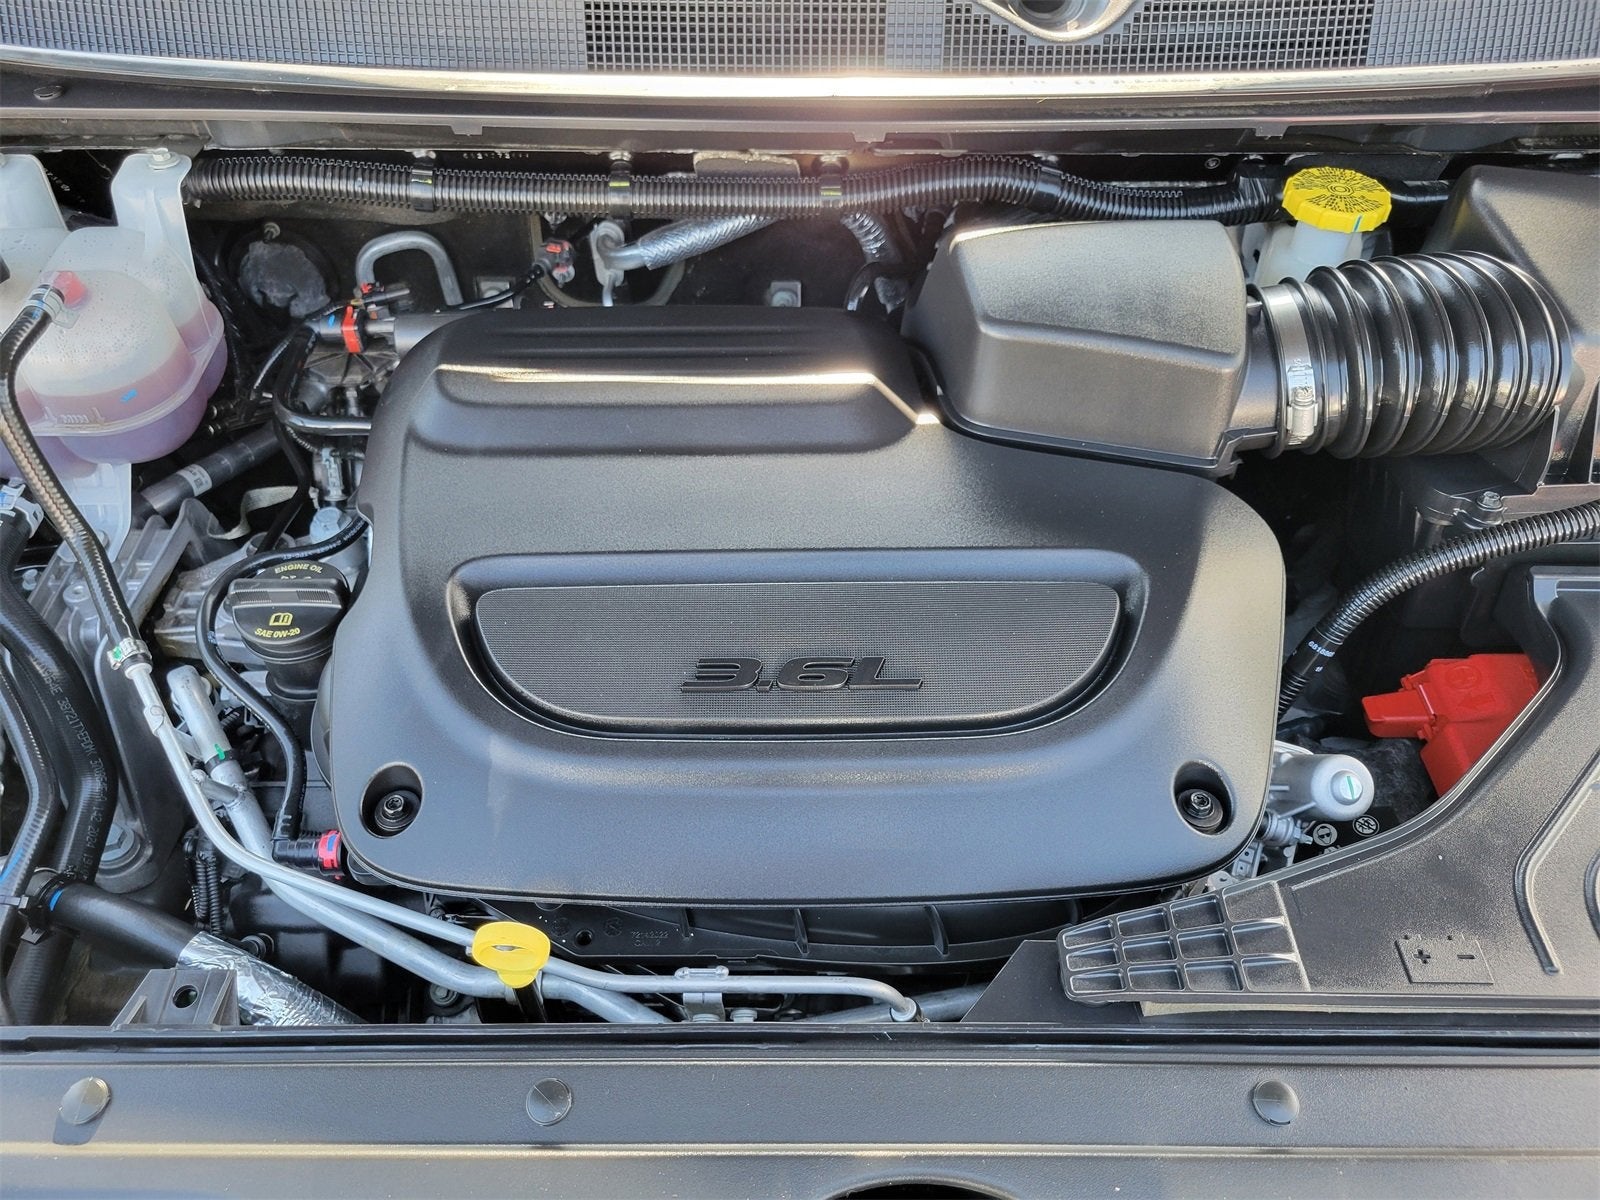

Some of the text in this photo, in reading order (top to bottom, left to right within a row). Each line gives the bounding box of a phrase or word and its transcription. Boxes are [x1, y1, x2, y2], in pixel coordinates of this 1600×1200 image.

[274, 563, 323, 574] ENGINE OIL
[254, 627, 301, 638] SAE 0W-20
[681, 656, 923, 693] 3.6L
